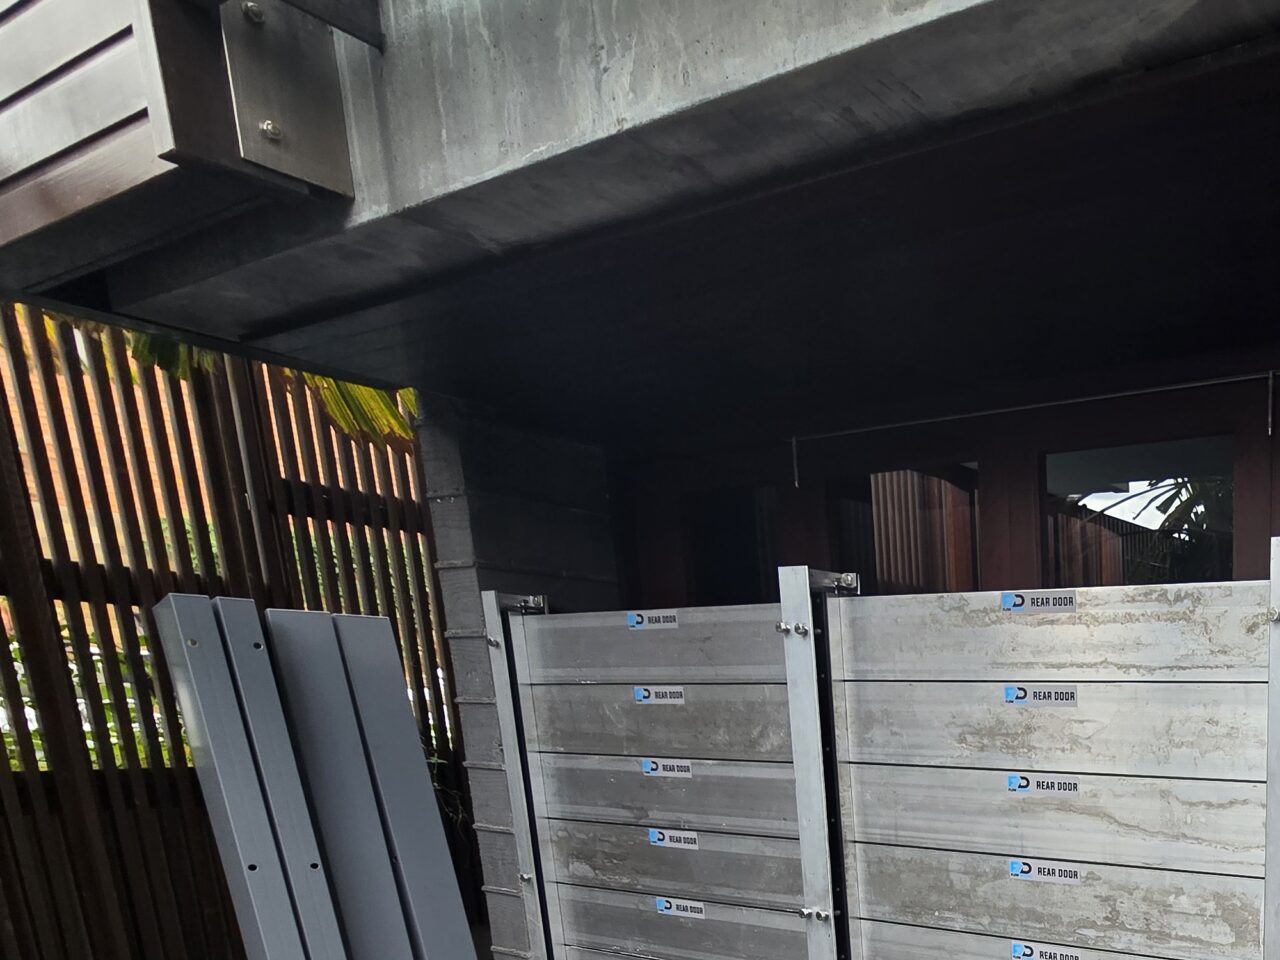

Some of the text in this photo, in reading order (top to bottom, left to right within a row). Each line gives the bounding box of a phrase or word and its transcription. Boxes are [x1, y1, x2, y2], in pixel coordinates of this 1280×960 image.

[1031, 597, 1073, 607] REAR DOOR
[1033, 691, 1075, 701] REAR DOOR
[1036, 781, 1078, 792] REAR DOOR
[1038, 867, 1078, 879] REAR DOOR
[1040, 951, 1057, 960] REAR
